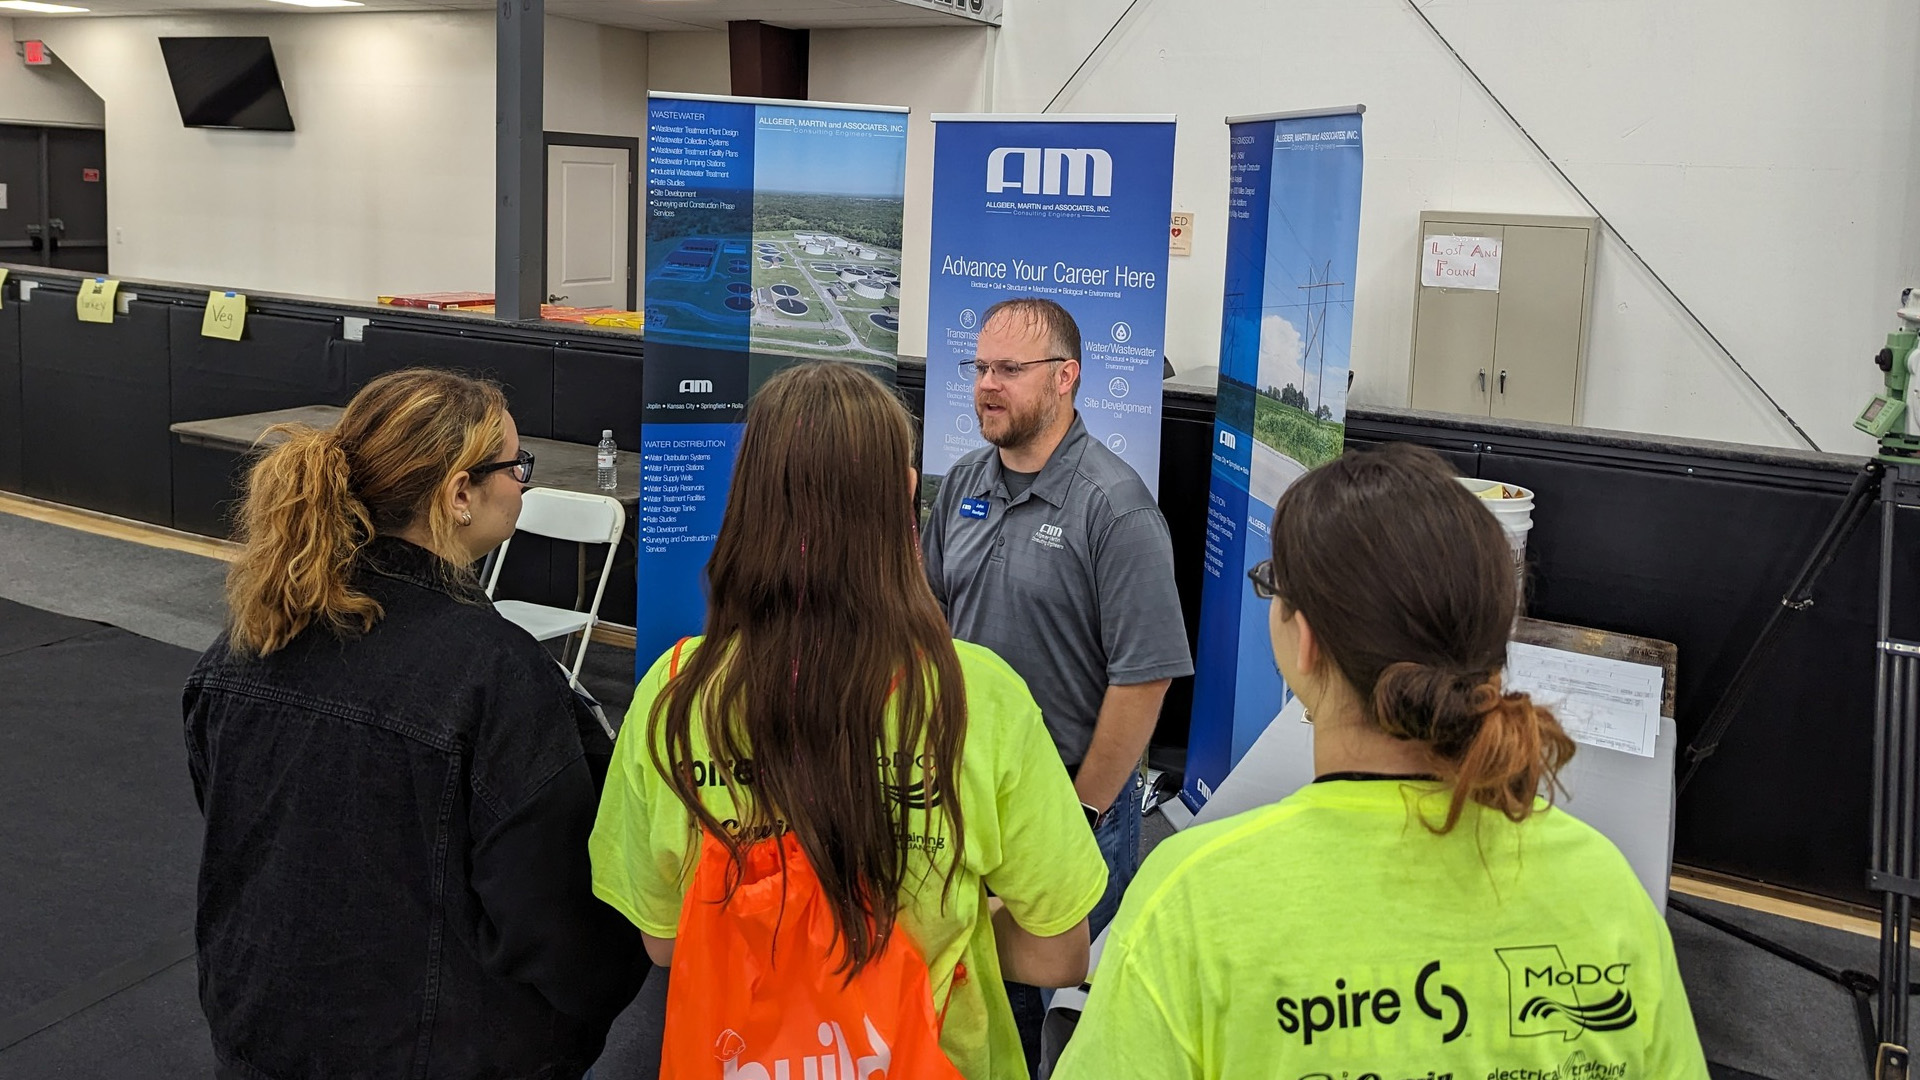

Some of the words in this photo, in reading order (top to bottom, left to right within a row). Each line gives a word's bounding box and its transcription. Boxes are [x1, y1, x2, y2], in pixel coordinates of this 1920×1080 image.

[651, 111, 705, 120] WASTEWATER
[759, 117, 797, 127] ALLGEIER,
[798, 120, 827, 128] MARTIN
[828, 121, 841, 129] and
[842, 122, 889, 132] ASSOCIATES,
[890, 124, 905, 133] INC.
[655, 125, 683, 133] Wastewater
[685, 126, 708, 134] Treatment
[722, 129, 739, 137] Design
[793, 127, 833, 137] Consulting
[835, 130, 872, 138] Engineers
[1346, 130, 1359, 139] INC.
[655, 136, 683, 144] Wastewater
[684, 137, 707, 145] Collection
[708, 138, 729, 147] Systems
[655, 146, 683, 154] Wastewater
[684, 148, 708, 156] Treatment
[709, 149, 724, 158] Facility
[655, 157, 683, 165] Wastewater
[684, 158, 705, 167] Pumping
[707, 159, 726, 167] Stations
[677, 169, 704, 177] Wastewater
[706, 170, 729, 178] Treatment
[654, 178, 666, 186] Rate
[665, 189, 697, 198] Development
[654, 200, 677, 208] Surveying
[689, 201, 719, 209] Construction
[720, 202, 735, 210] Phase
[985, 201, 1016, 209] ALLGEIER,
[1054, 204, 1096, 213] ASSOCIATES,
[1097, 205, 1110, 213] INC.
[1171, 216, 1188, 226] ED
[941, 255, 1007, 279] Advance
[1012, 259, 1048, 281] Your
[1053, 262, 1109, 286] Career
[1115, 265, 1156, 289] Here
[970, 281, 988, 289] Electrical
[1007, 284, 1027, 292] Structural
[1032, 285, 1057, 293] Mechanical
[1063, 288, 1083, 296] Biological
[1088, 289, 1121, 298] Environmental
[212, 304, 233, 328] Veg
[946, 327, 980, 340] Transmiss
[1084, 341, 1157, 357] Water/Wastewater
[1084, 397, 1099, 408] Site
[1101, 399, 1152, 414] Development
[673, 440, 726, 448] DISTRIBUTION
[690, 453, 711, 462] Systems
[663, 464, 685, 472] Pumping
[663, 475, 679, 483] Supply
[663, 485, 679, 493] Supply
[662, 505, 681, 513] Storage
[682, 504, 696, 512] Tanks
[656, 525, 688, 533] Development
[646, 536, 670, 544] Surveying
[1276, 978, 1401, 1046] spire
[1487, 1064, 1561, 1080] electrical
[1572, 1060, 1627, 1077] training
